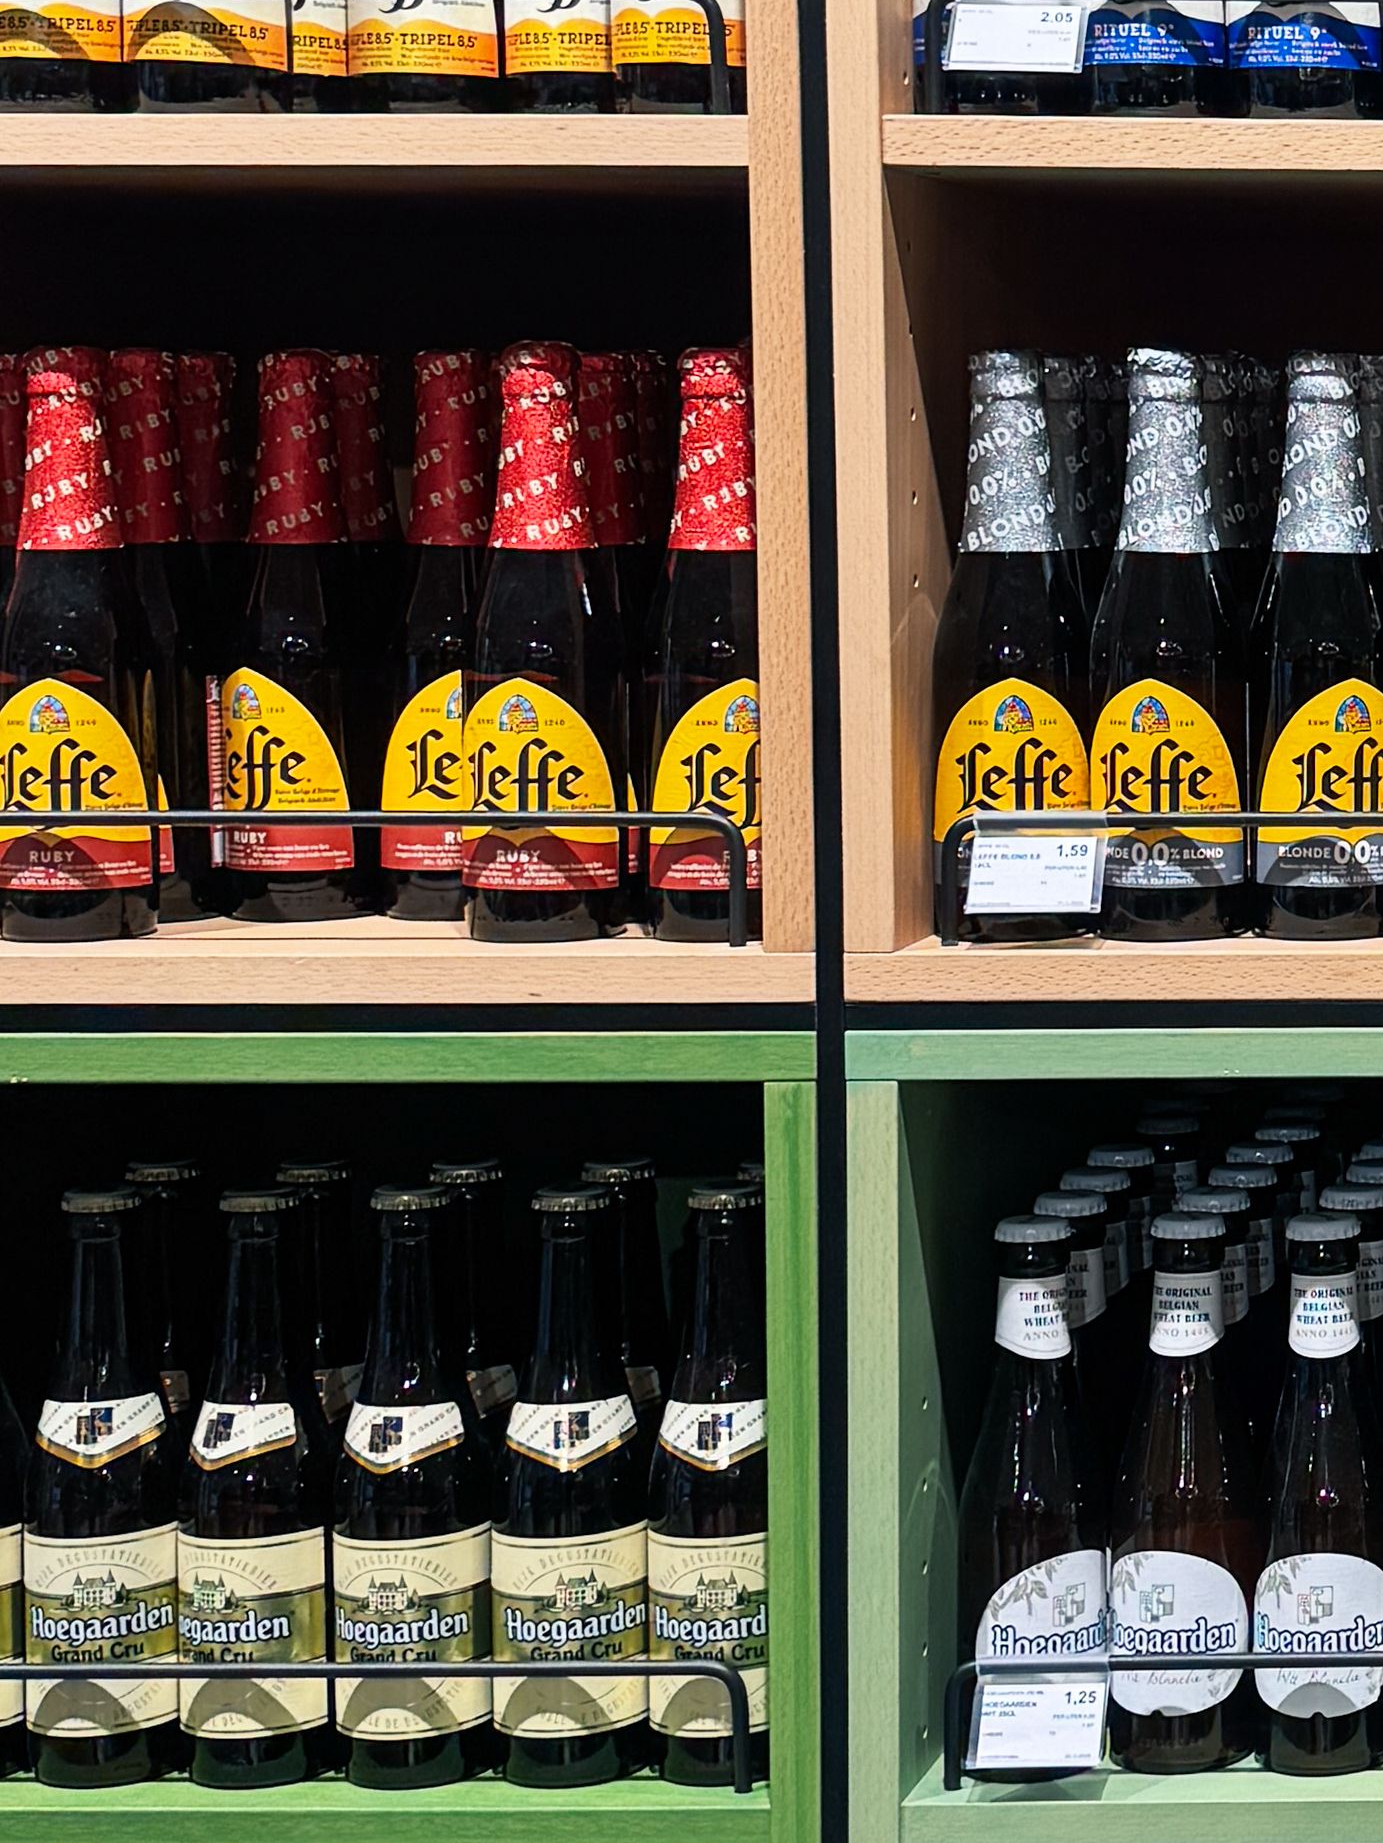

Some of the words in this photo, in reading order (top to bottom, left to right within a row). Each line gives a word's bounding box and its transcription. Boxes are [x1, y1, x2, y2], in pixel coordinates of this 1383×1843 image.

[1040, 11, 1074, 25] 2,05
[1095, 24, 1151, 38] RITUEL
[1247, 25, 1304, 41] RITUEL
[400, 33, 455, 48] TRIPEL
[234, 830, 268, 845] RUBY
[29, 849, 76, 864] RUBY
[496, 847, 541, 864] RUBY
[1056, 843, 1089, 858] 1,59
[1182, 847, 1224, 859] BLOND
[30, 1600, 175, 1648] Hoegaarden
[335, 1605, 470, 1651] Hoegaarden
[505, 1600, 647, 1647] Hoegaarden
[109, 1638, 145, 1660] Cru
[589, 1638, 623, 1659] Cru
[1063, 1691, 1097, 1705] 1,25
